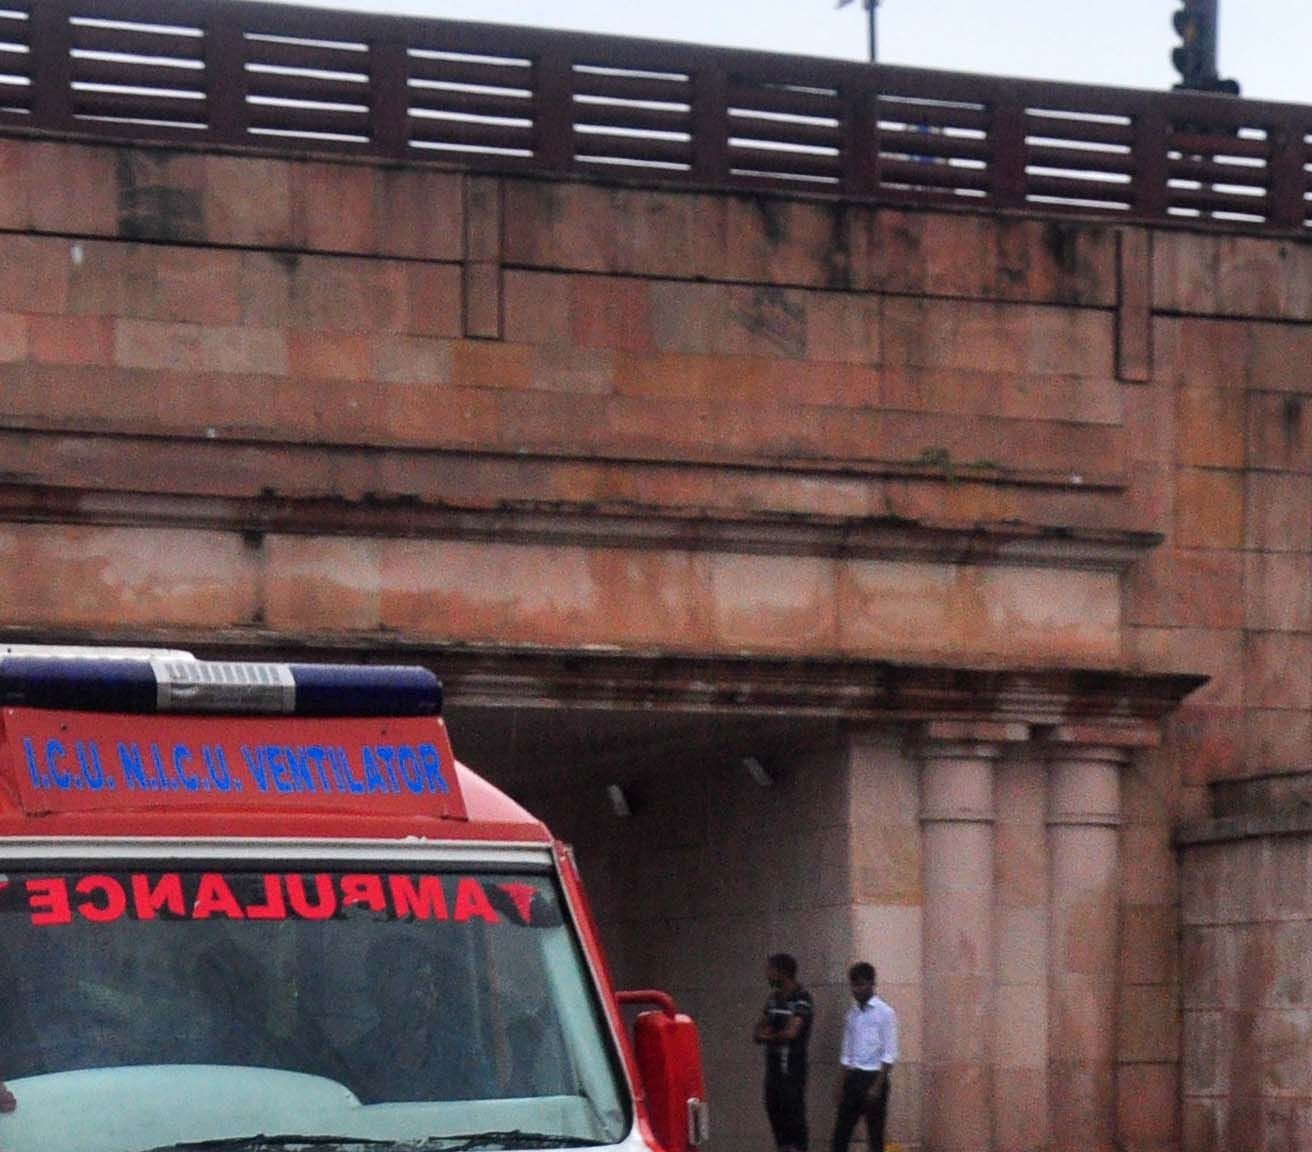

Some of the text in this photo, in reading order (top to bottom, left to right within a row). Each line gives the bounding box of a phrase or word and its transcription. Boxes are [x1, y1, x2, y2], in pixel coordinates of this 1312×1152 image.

[23, 738, 449, 795] I.C.U. N.I.C.U. VENTILATOR
